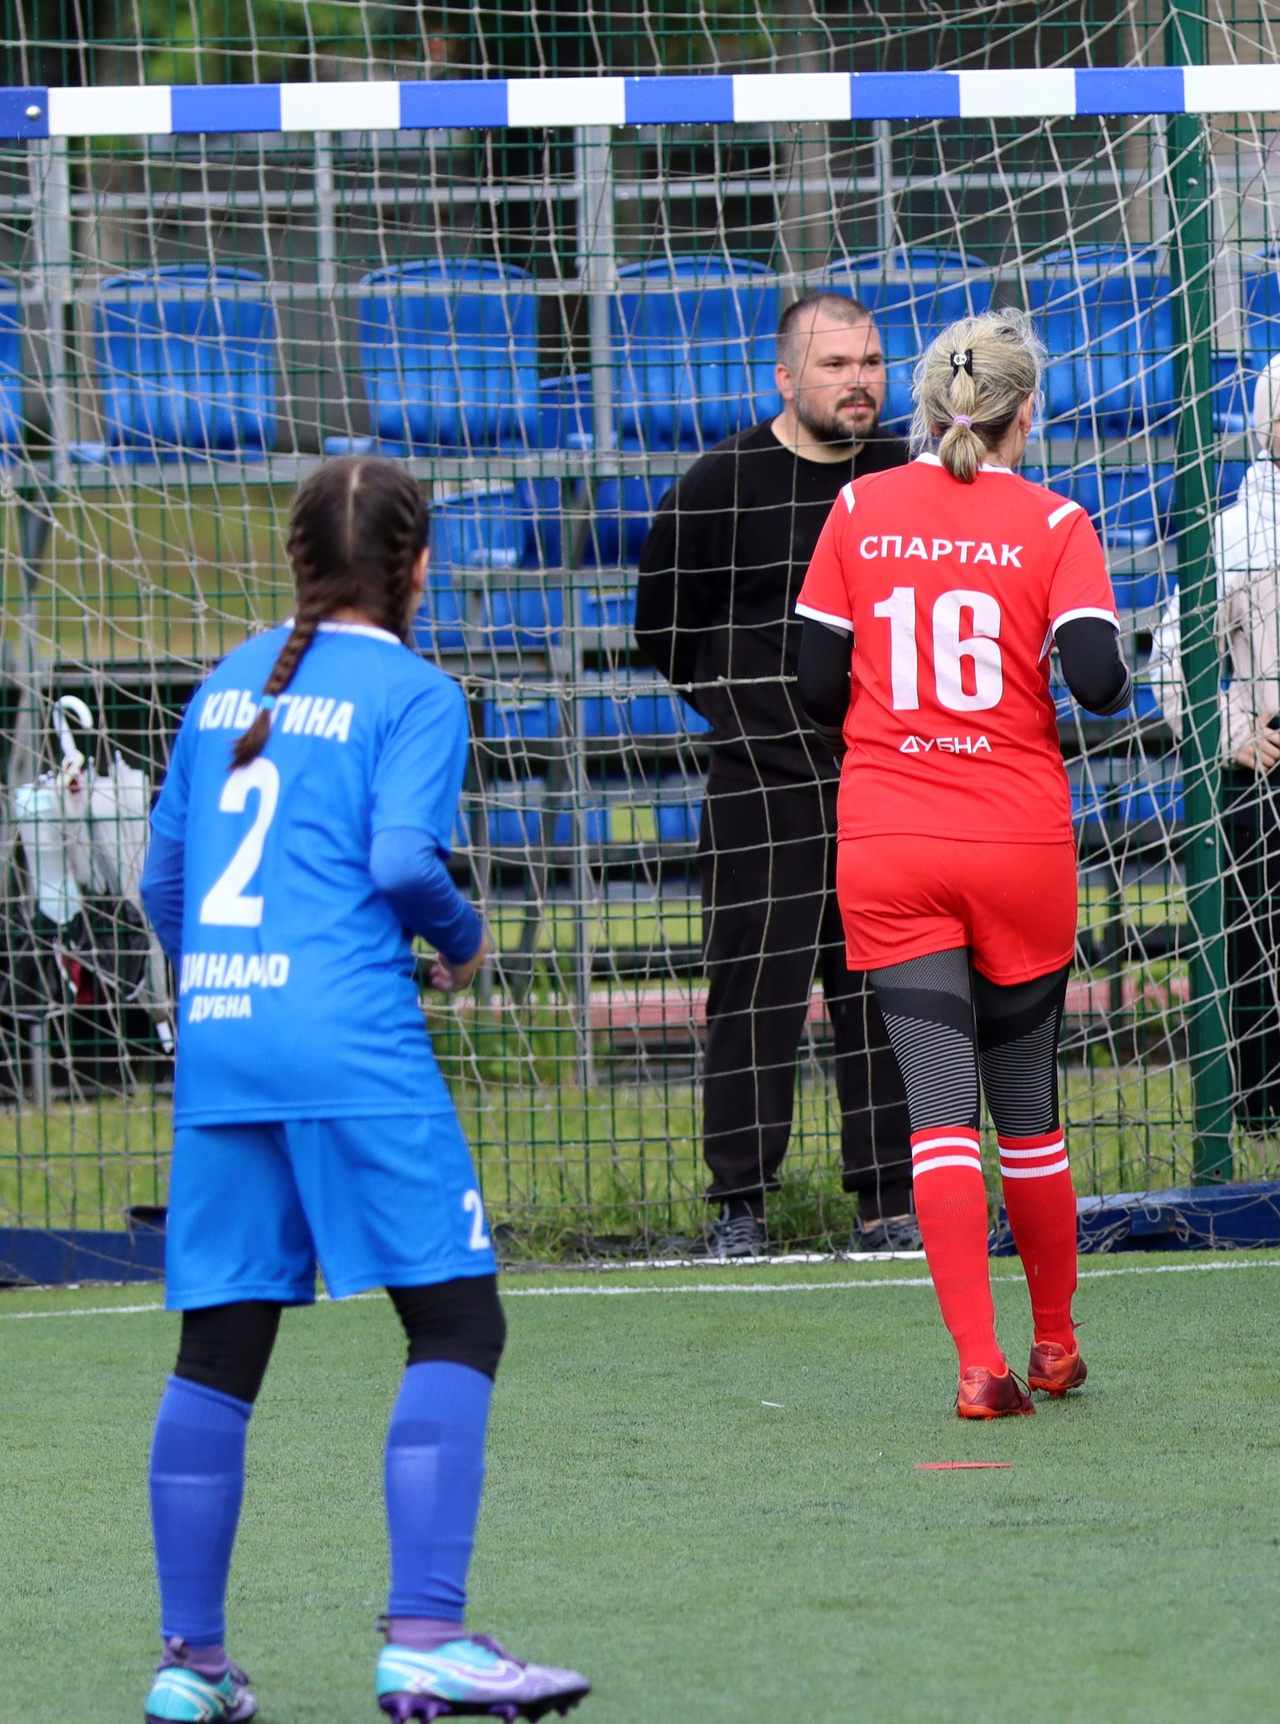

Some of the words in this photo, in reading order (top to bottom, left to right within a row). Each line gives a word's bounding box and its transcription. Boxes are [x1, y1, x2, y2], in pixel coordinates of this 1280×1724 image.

[860, 535, 1024, 568] СПАРТАК
[873, 587, 1004, 712] 16
[899, 734, 993, 755] ДУБНА
[199, 757, 280, 928] 2
[180, 953, 290, 995] ДИНАМО
[188, 994, 253, 1023] ДУБНА
[463, 1189, 491, 1250] 2
